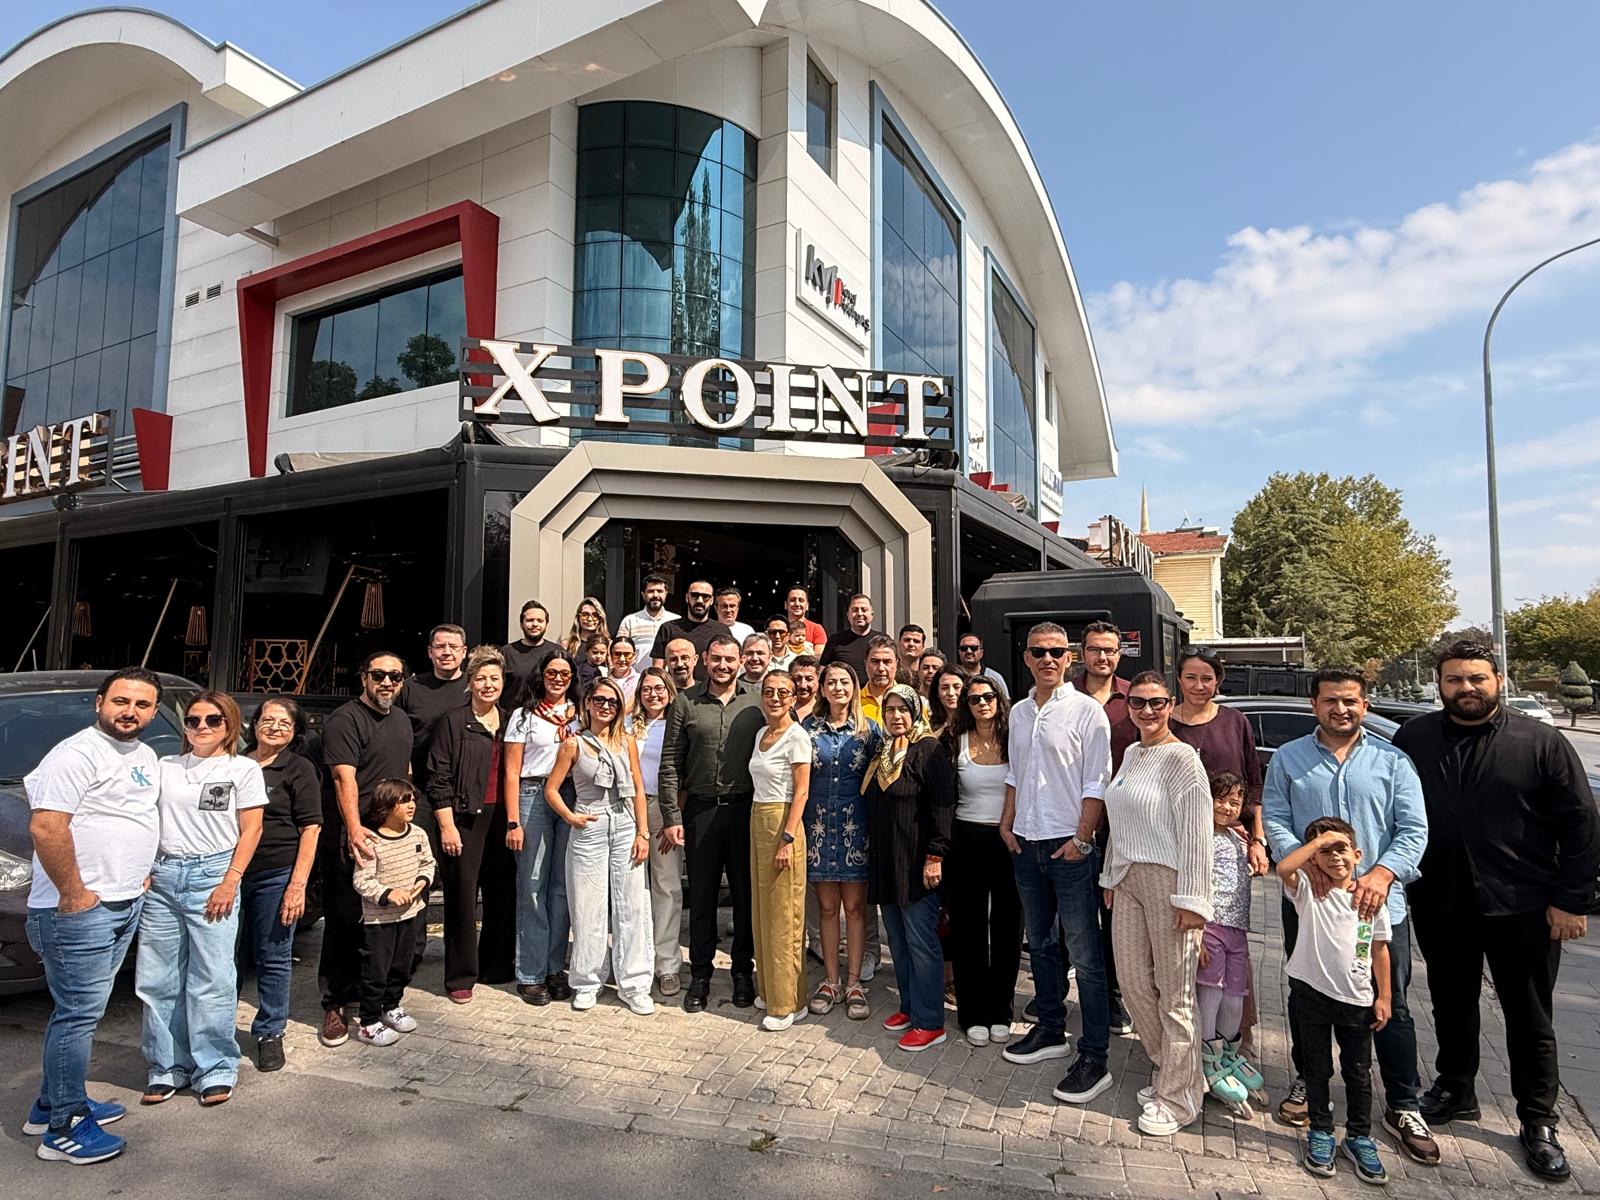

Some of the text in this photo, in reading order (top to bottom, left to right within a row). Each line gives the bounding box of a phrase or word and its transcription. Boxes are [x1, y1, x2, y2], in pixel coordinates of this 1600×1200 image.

[474, 339, 945, 441] X POINT
[1, 412, 98, 498] INT
